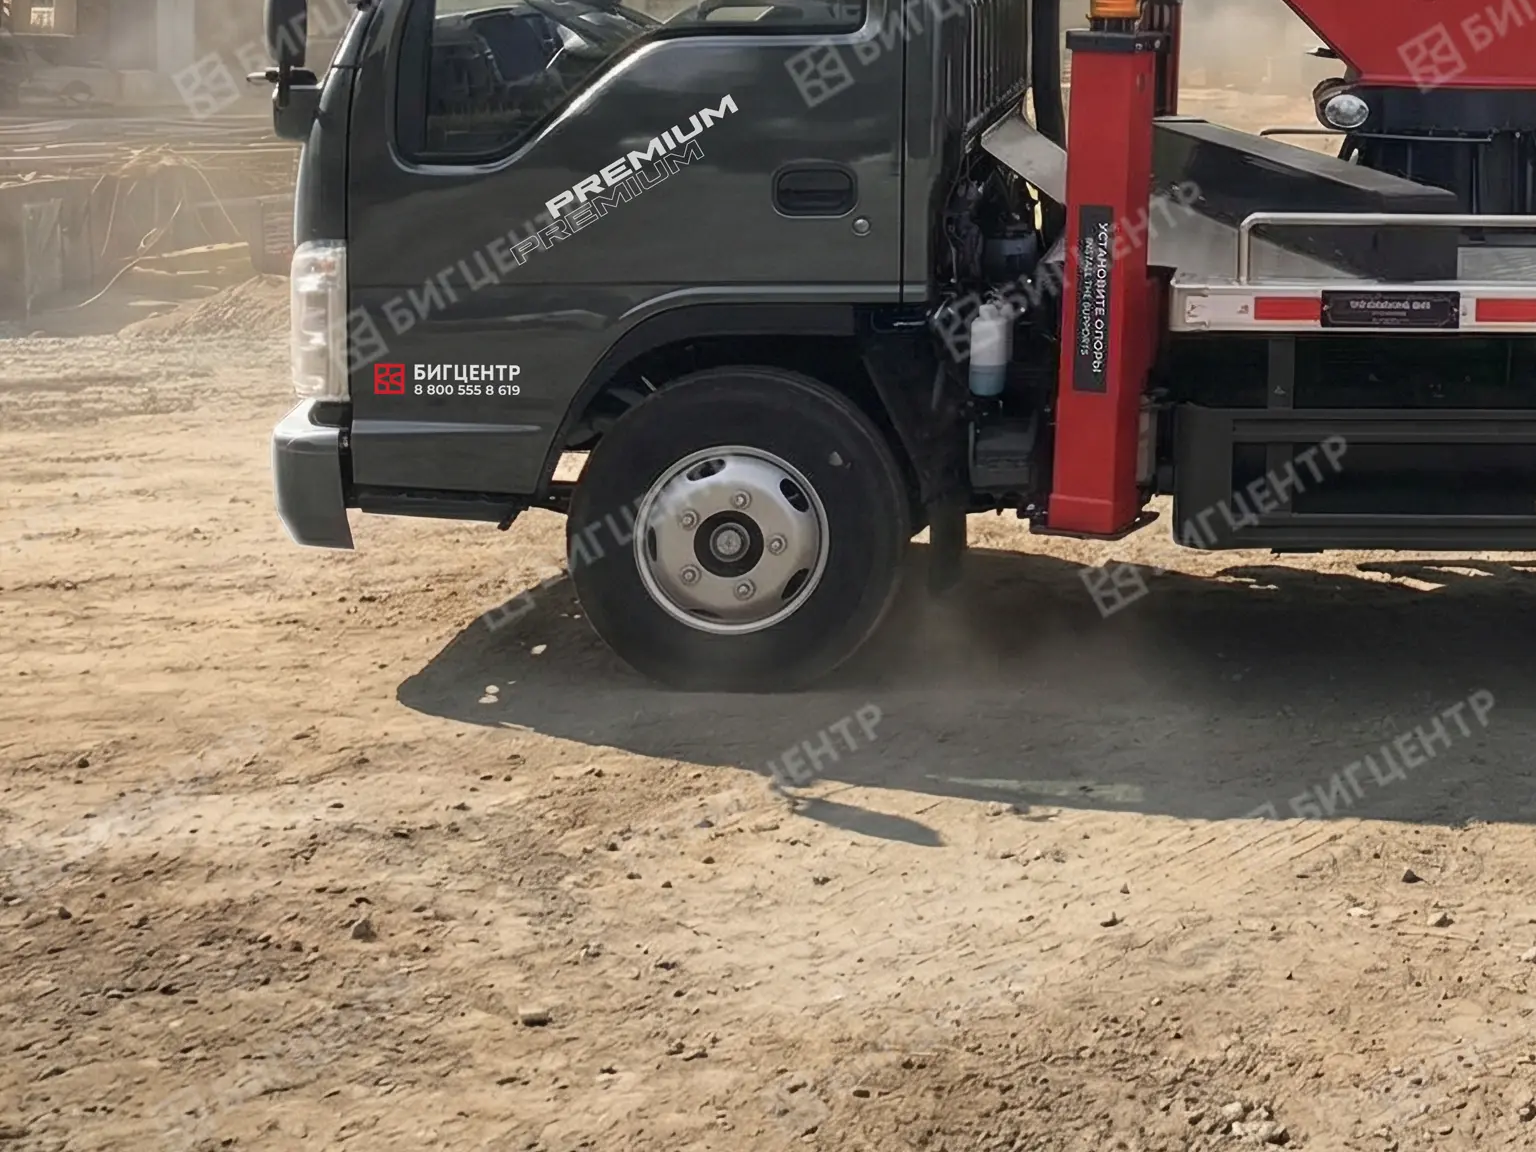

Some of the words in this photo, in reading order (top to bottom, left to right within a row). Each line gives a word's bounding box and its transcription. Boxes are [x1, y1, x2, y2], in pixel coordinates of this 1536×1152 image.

[544, 93, 739, 219] PREMIUM
[509, 139, 705, 266] PREMIUM
[1092, 318, 1106, 373] ОПОРЫ
[413, 364, 521, 383] БИГЦЕНТР
[413, 384, 423, 395] 8
[426, 384, 454, 395] 800
[457, 384, 482, 395] 555
[485, 384, 494, 396] 8
[498, 384, 521, 396] 619
